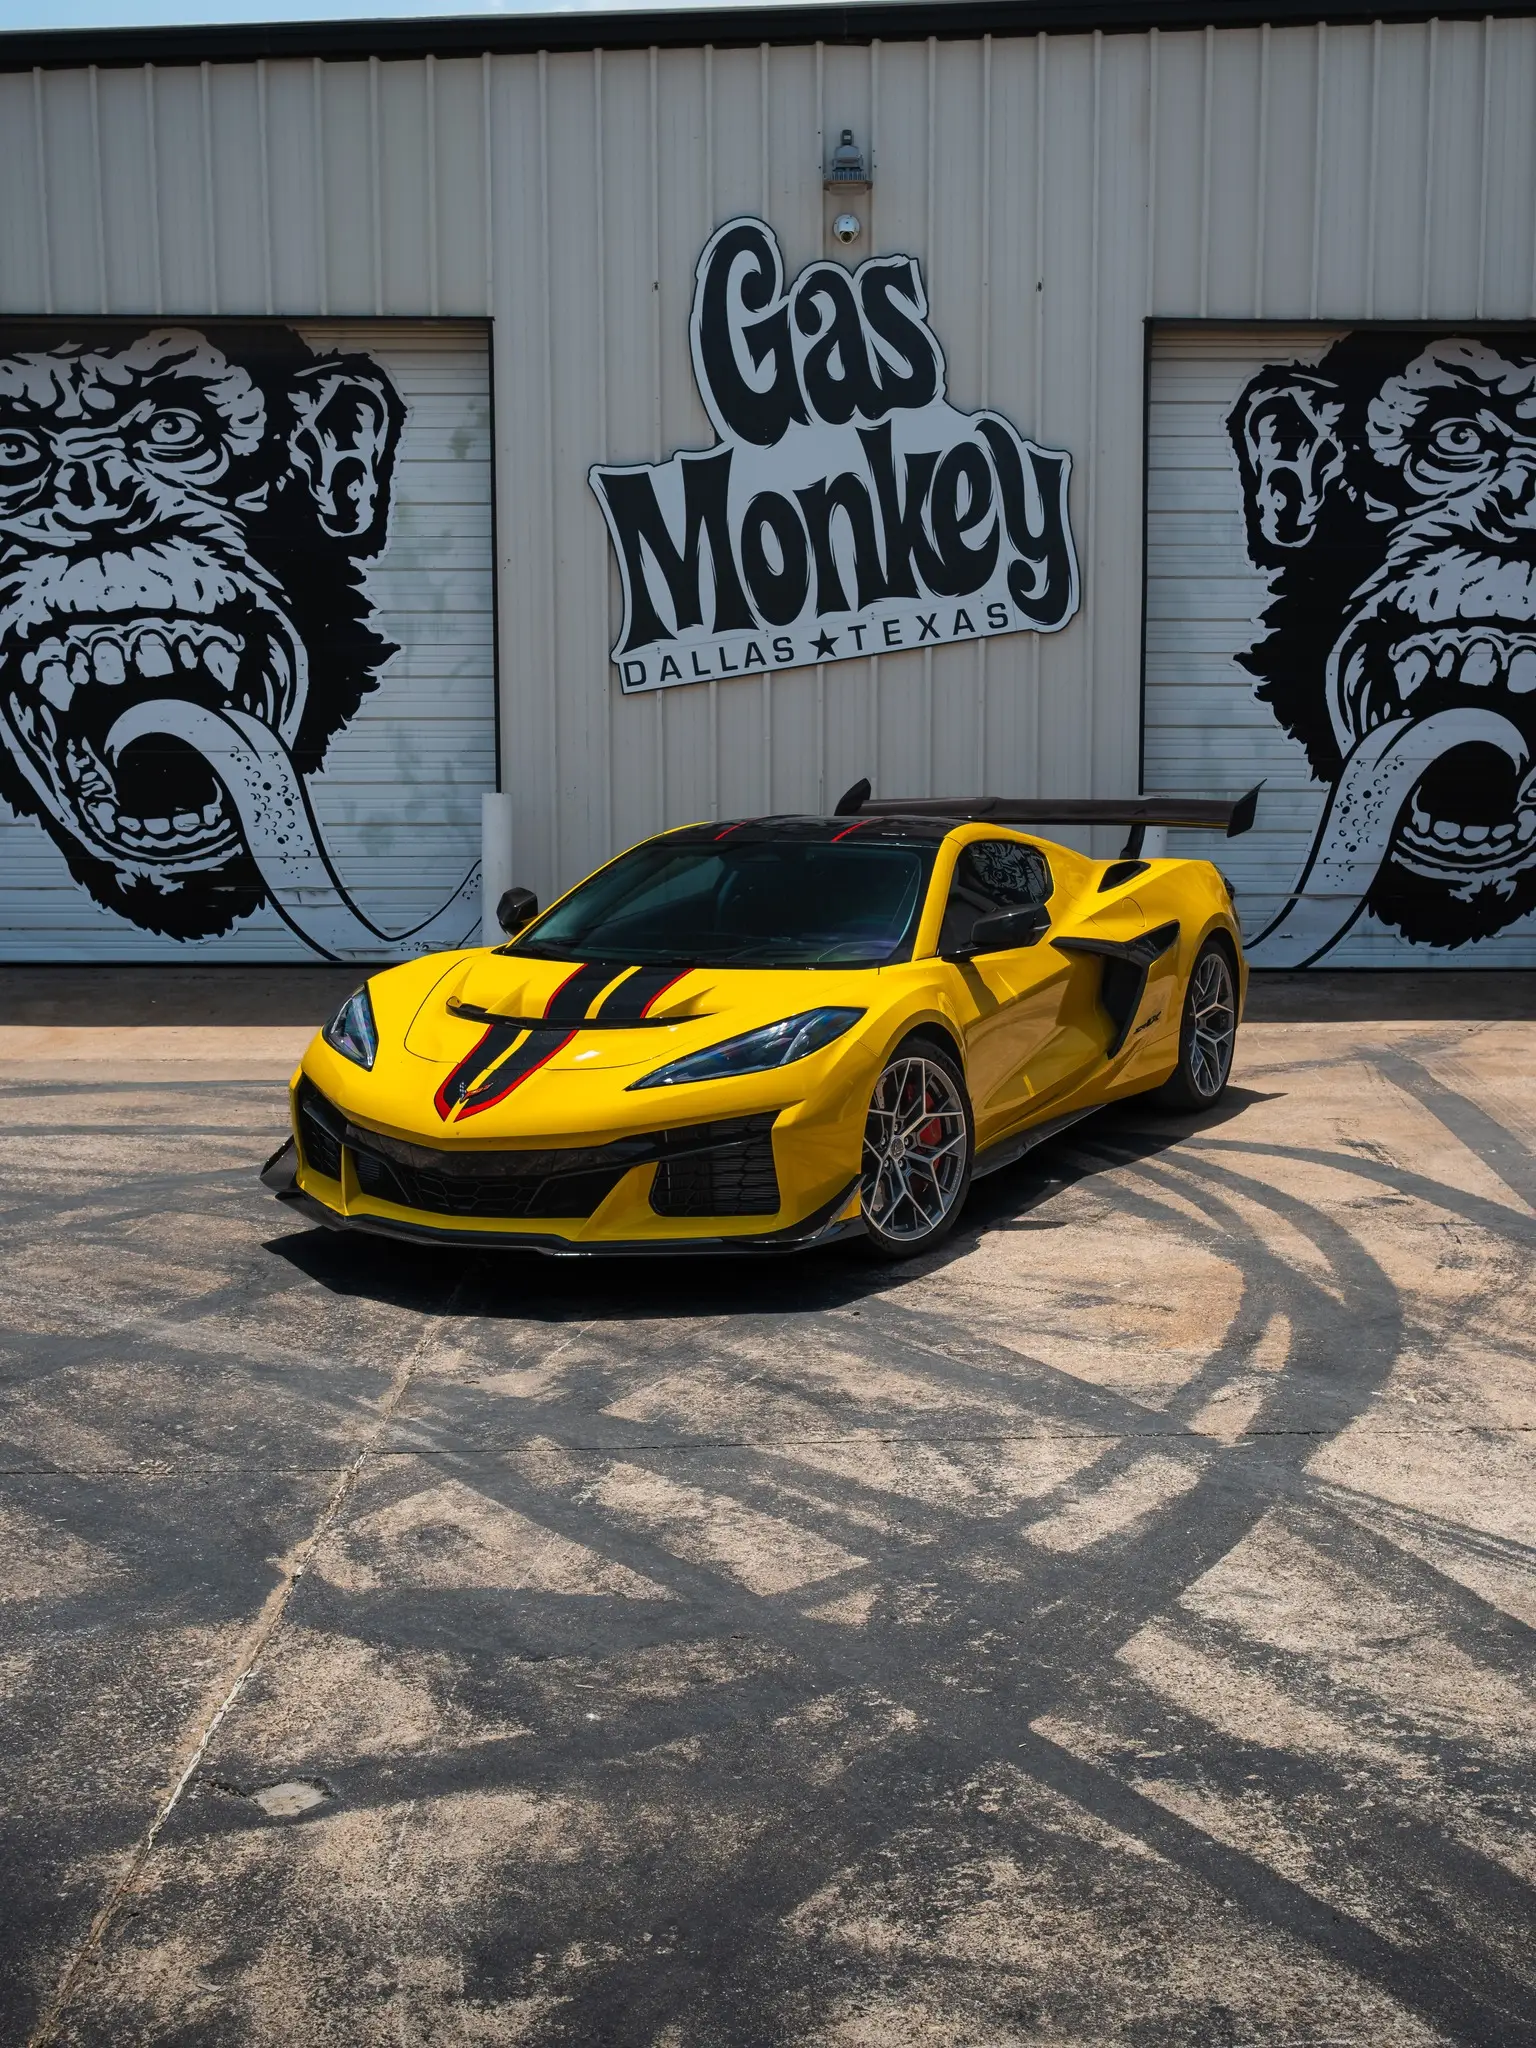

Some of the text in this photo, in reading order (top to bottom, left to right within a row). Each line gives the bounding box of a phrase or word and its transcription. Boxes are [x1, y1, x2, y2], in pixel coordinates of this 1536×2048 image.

[700, 225, 938, 449] Gas
[597, 417, 1073, 655] Monkey
[623, 602, 1009, 687] DALLAS TEXAS
